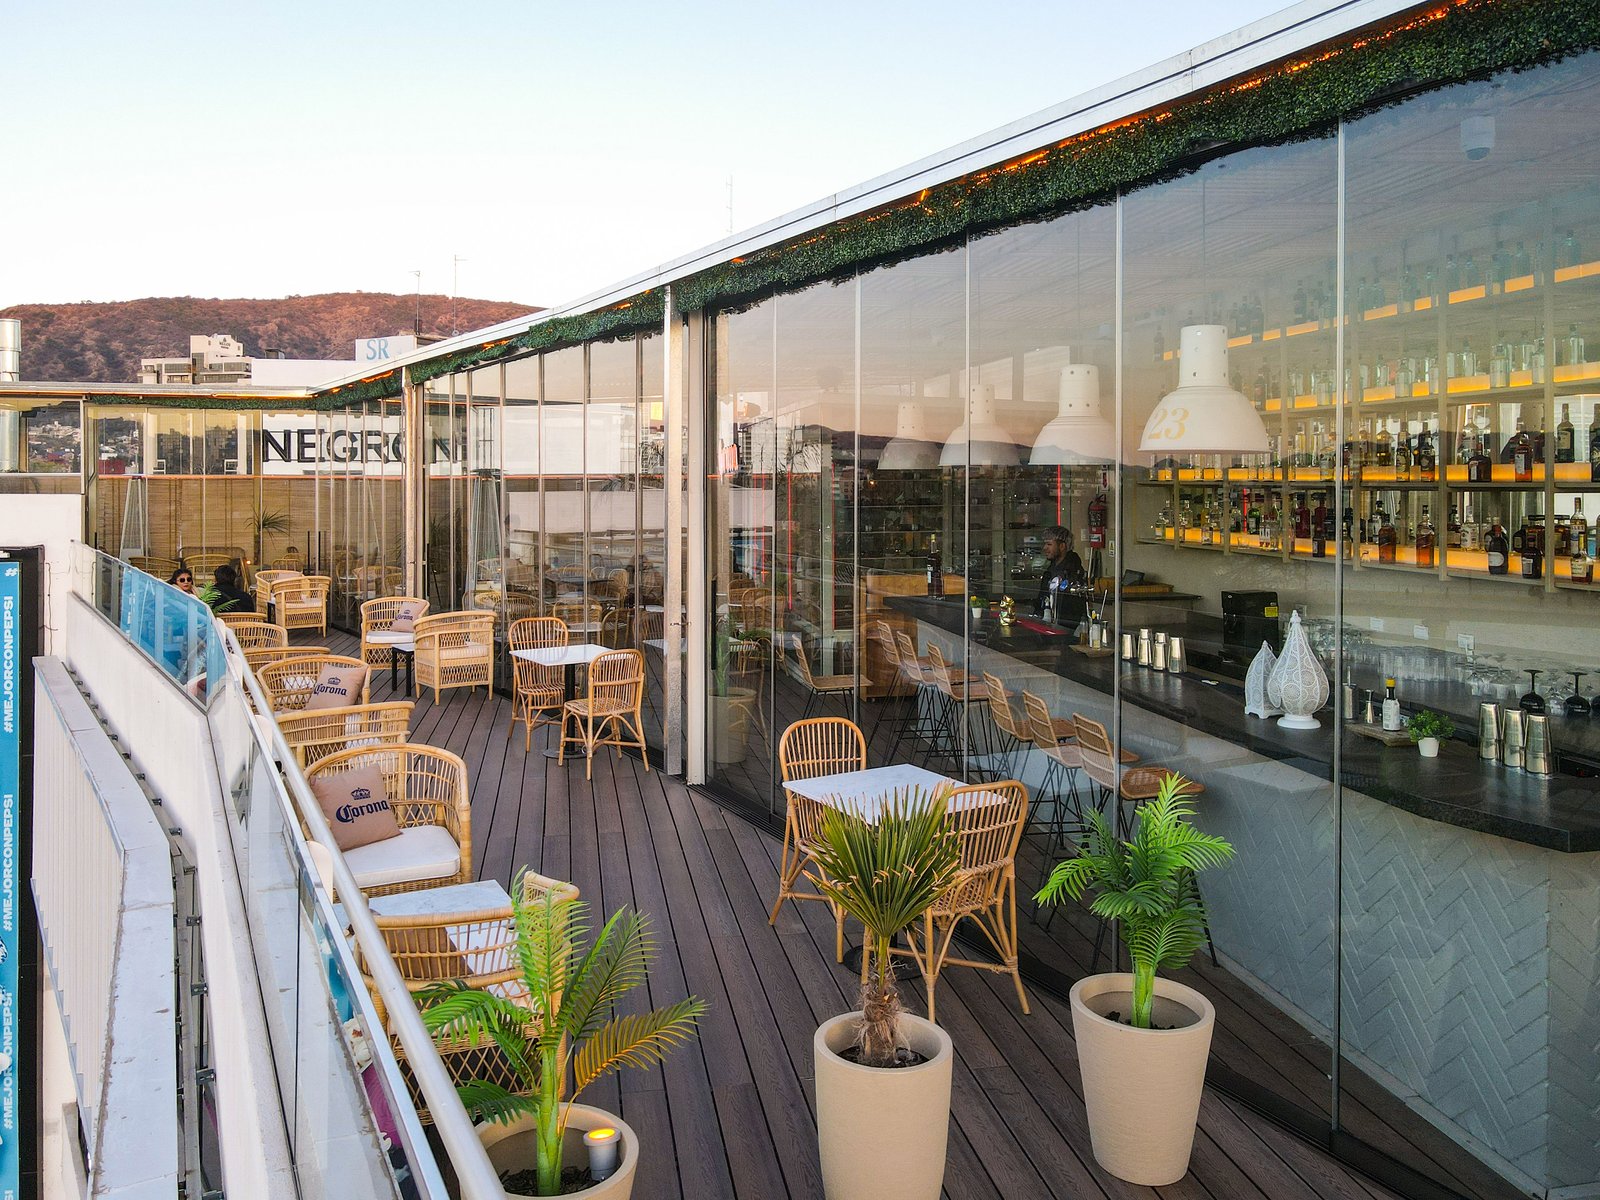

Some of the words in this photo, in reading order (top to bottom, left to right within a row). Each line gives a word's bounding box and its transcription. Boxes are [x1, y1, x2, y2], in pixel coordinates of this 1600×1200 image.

[366, 339, 390, 361] SR
[1148, 407, 1190, 440] 23
[4, 597, 14, 733] #MEJORCONPEPSI
[313, 683, 347, 696] Corona
[335, 799, 389, 823] Corona
[4, 794, 14, 931] #MEJORCONPEPSI
[4, 993, 13, 1129] #MEJORONPEPSI
